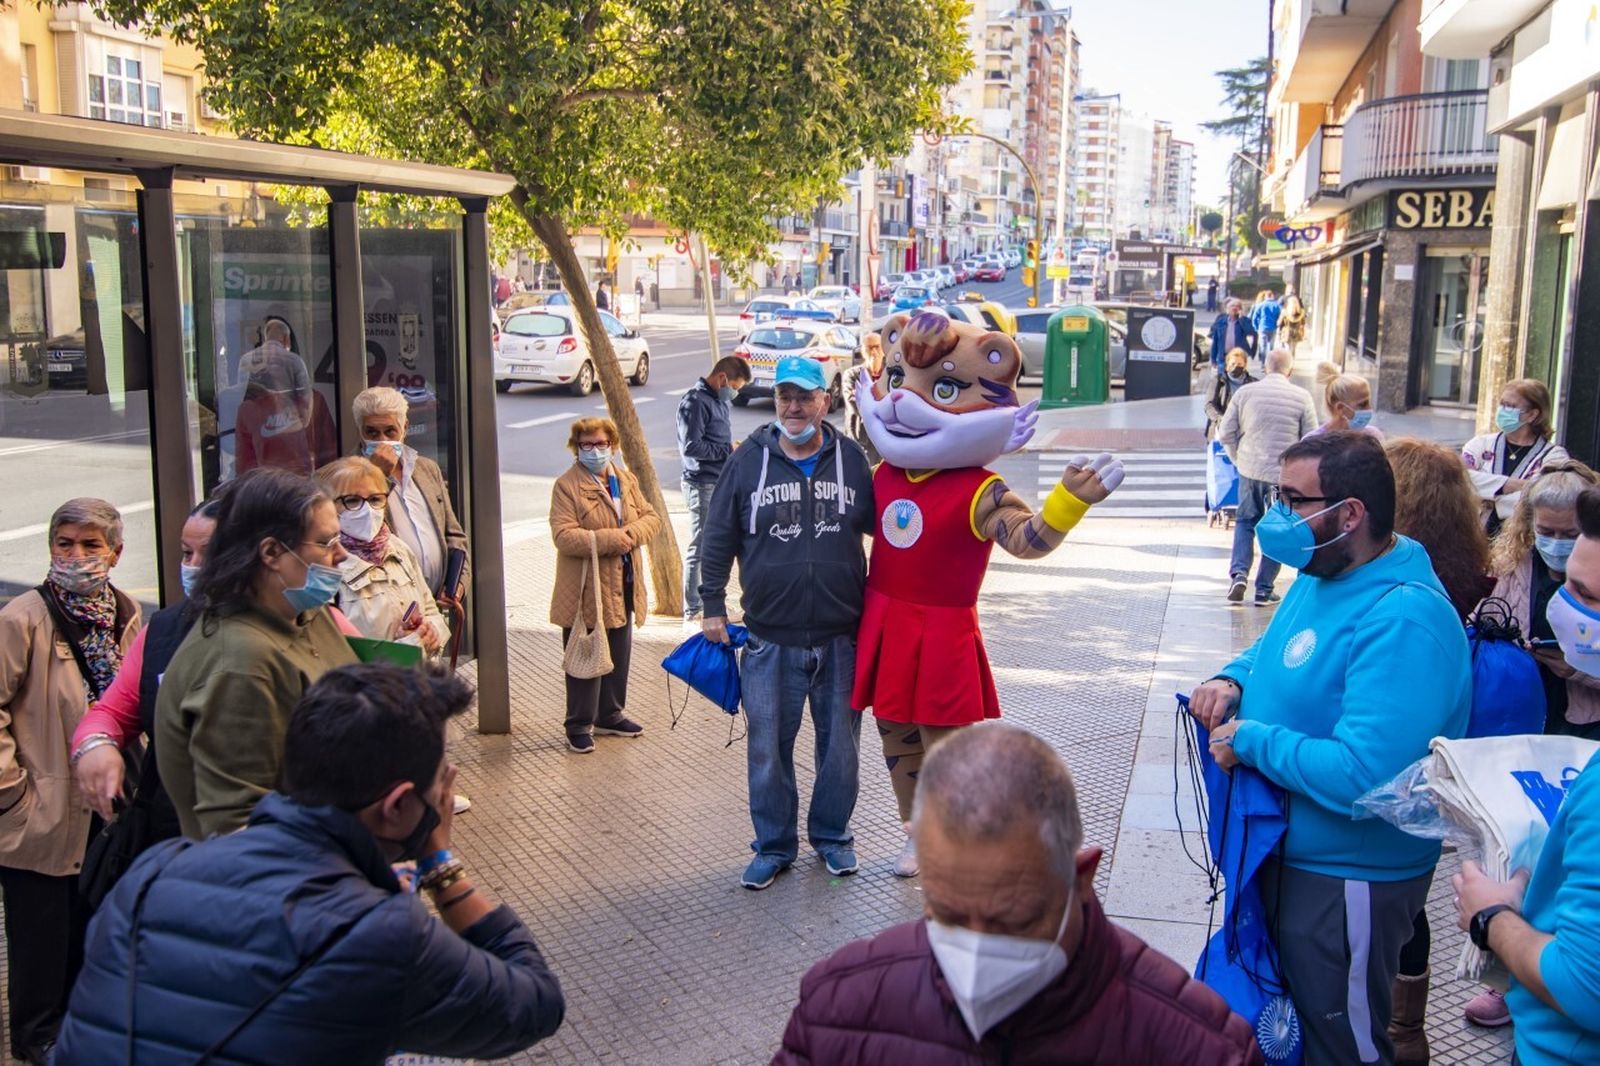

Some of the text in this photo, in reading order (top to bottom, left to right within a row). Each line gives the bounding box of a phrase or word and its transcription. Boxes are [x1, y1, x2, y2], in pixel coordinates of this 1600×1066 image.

[1396, 190, 1494, 228] SEBA
[224, 267, 330, 295] Sprinte
[815, 481, 856, 507] SUPLY
[769, 521, 841, 542] Quality Goods
